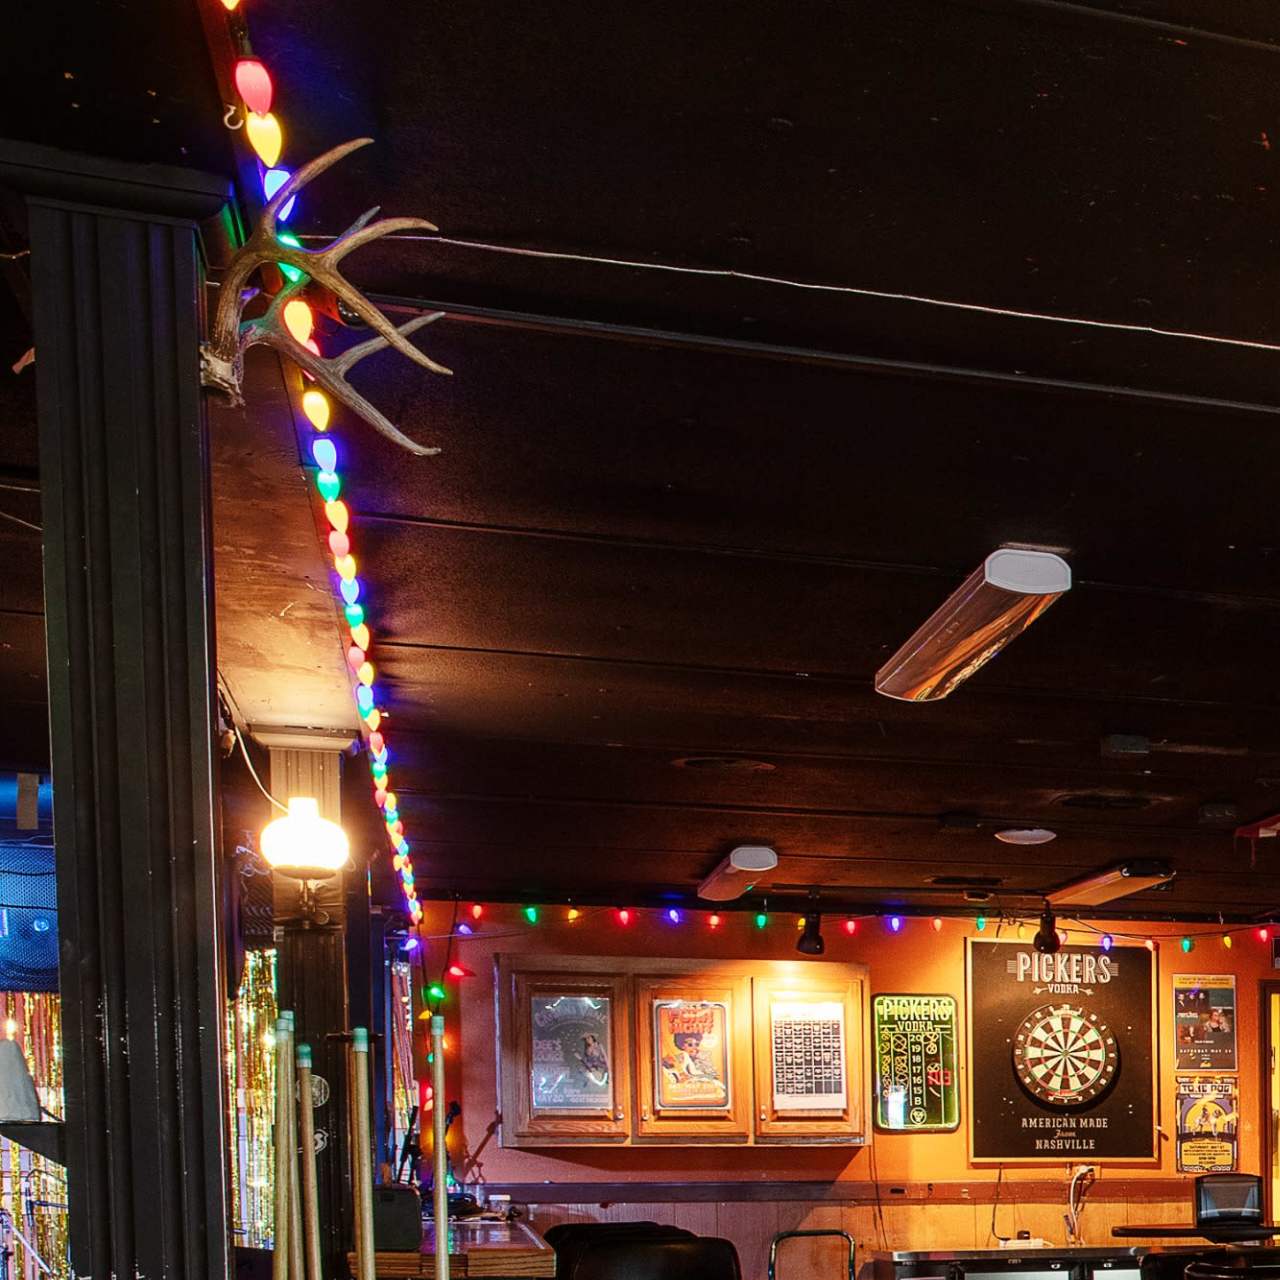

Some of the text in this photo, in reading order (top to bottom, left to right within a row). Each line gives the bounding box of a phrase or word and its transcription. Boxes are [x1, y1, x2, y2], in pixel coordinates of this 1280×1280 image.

[1016, 951, 1111, 984] PICKERS
[1047, 984, 1079, 994] VODKA
[883, 1000, 950, 1021] PICKERS
[897, 1020, 934, 1032] VODKA
[910, 1034, 922, 1042] 20
[911, 1044, 921, 1053] 19
[912, 1055, 921, 1063] 18
[912, 1076, 922, 1084] 16
[913, 1087, 922, 1095] 15
[914, 1097, 922, 1106] B
[1021, 1117, 1109, 1128] AMERICAN MADE
[1035, 1139, 1096, 1150] NASHVILLE
